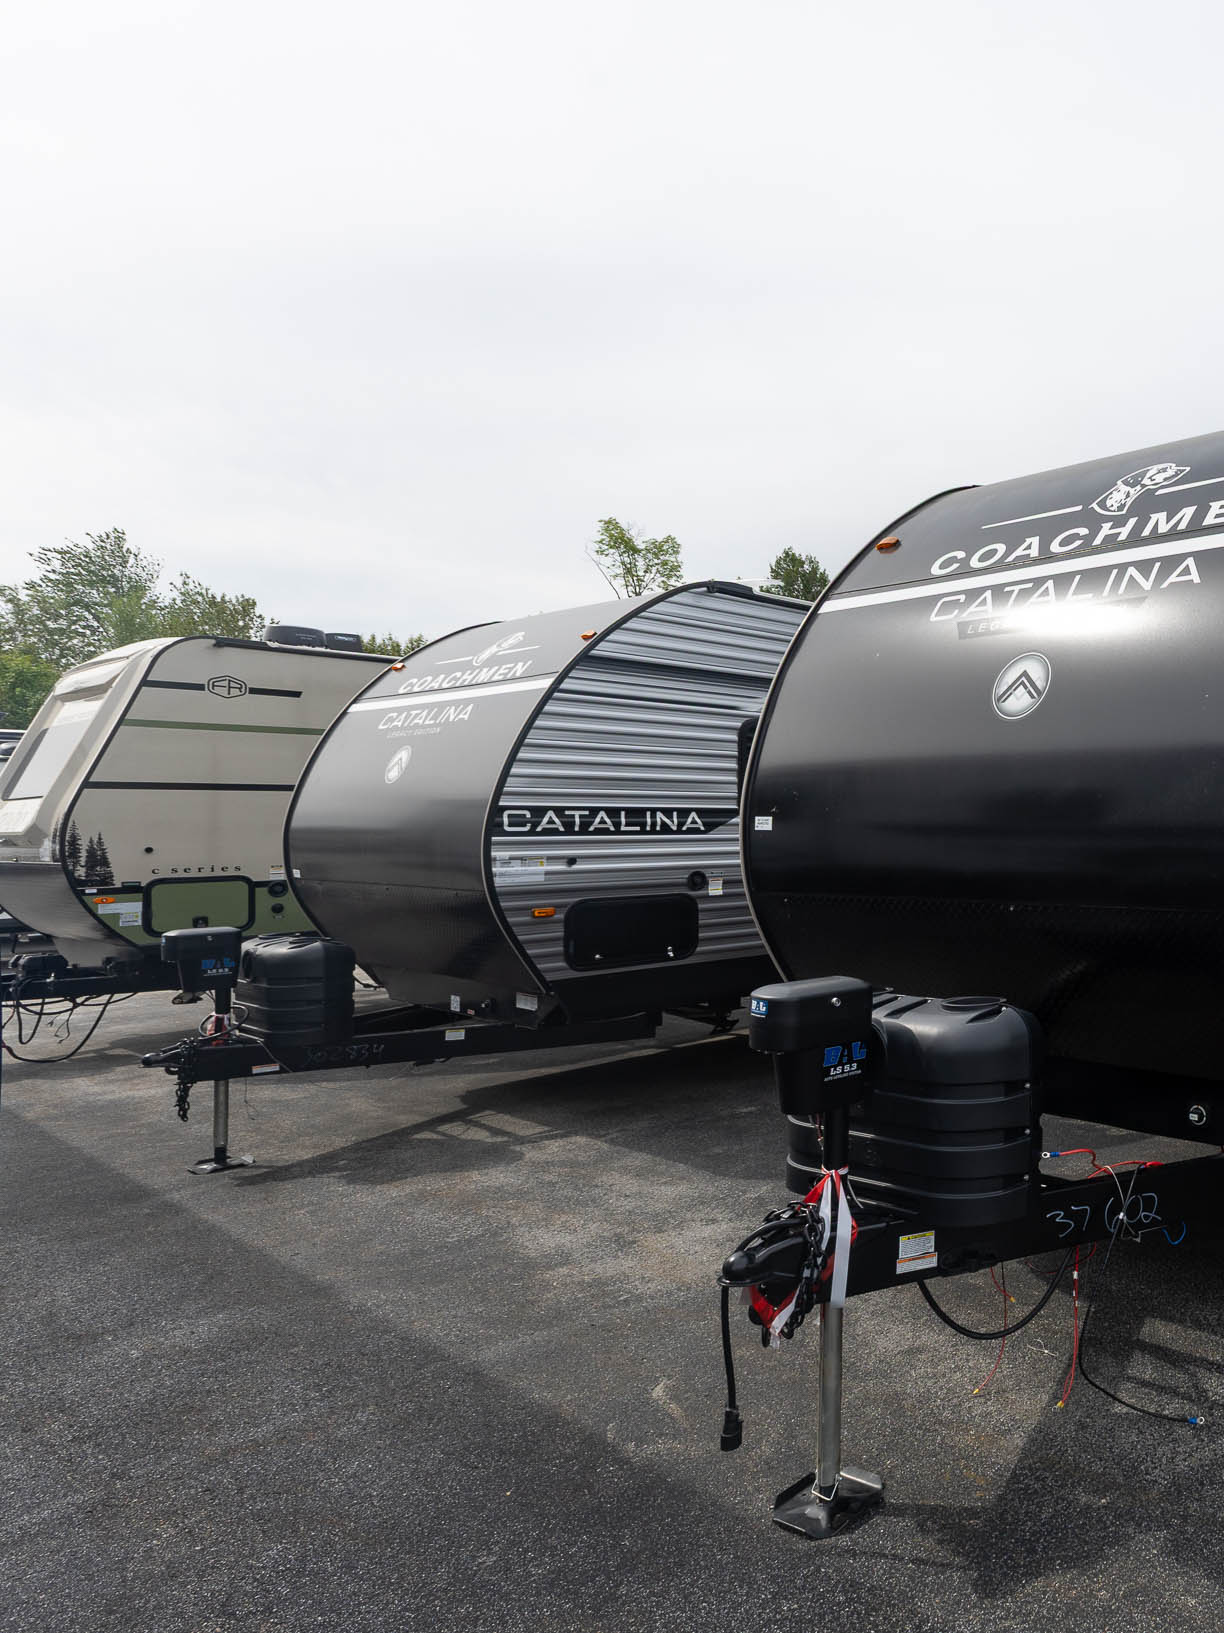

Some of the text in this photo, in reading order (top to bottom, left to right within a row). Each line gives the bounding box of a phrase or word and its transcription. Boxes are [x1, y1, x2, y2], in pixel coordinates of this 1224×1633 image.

[929, 556, 1202, 623] CATALINA
[398, 660, 533, 693] COACHMEN
[378, 703, 474, 730] CATALINA
[502, 809, 705, 832] CATALINA
[170, 864, 242, 874] series
[830, 1066, 843, 1076] LS
